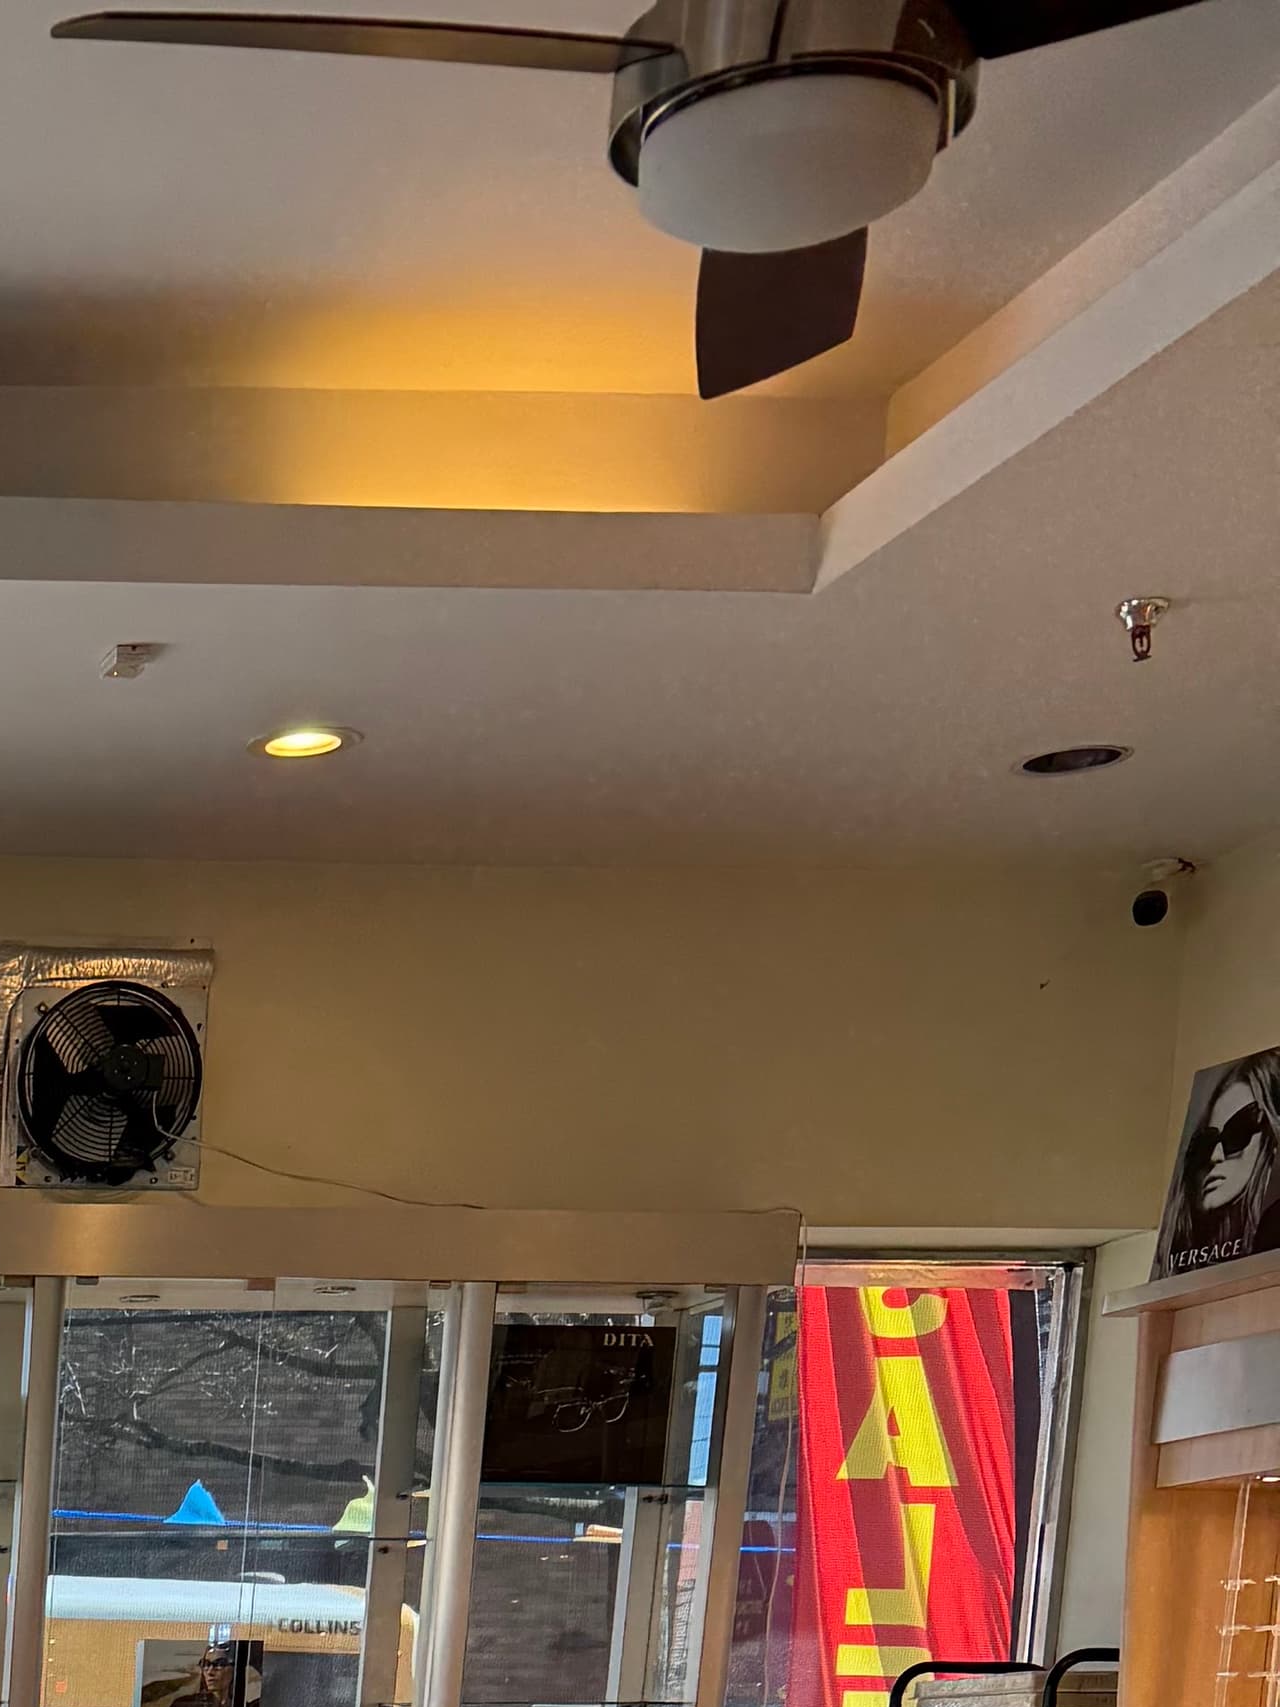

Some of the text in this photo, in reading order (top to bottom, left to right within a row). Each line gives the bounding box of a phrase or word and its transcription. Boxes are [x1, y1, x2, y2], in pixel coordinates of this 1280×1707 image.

[1169, 1239, 1241, 1271] VERSACE
[603, 1332, 655, 1347] DITA
[278, 1618, 362, 1636] COLLINS
